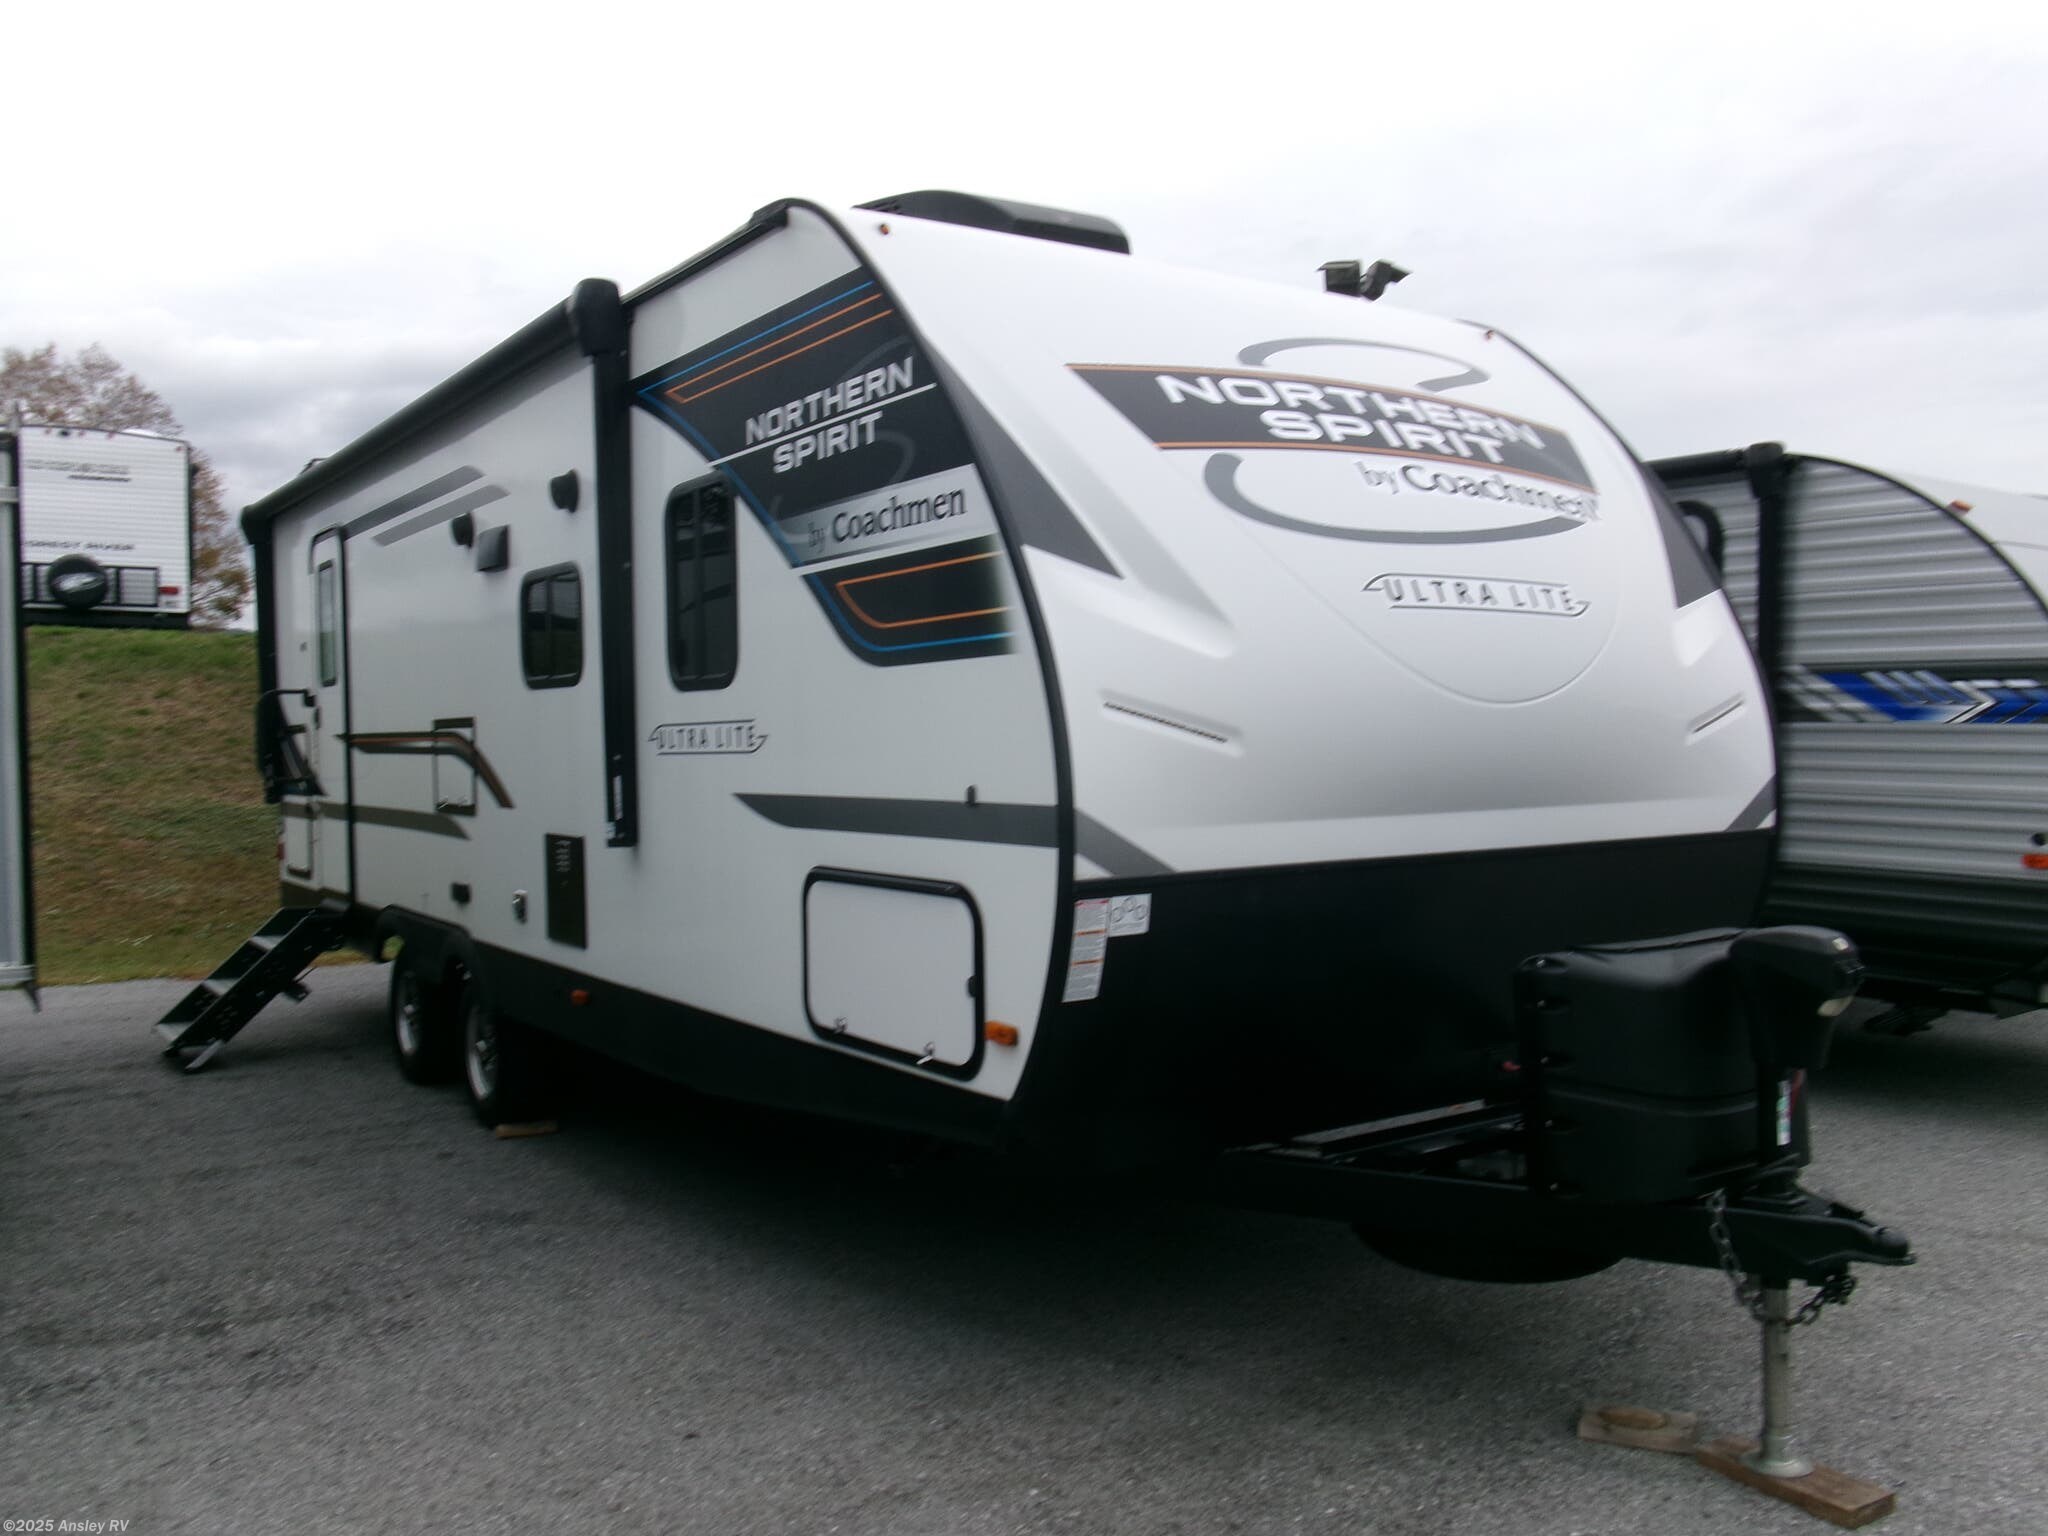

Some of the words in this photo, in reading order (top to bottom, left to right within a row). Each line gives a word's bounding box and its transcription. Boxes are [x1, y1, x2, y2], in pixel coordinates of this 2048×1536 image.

[745, 356, 914, 446] NORTHERN
[1155, 374, 1546, 450] NORTHERN
[773, 410, 883, 474] SPIRIT
[1259, 409, 1505, 464] SPIRIT
[807, 521, 826, 553] by
[832, 488, 968, 543] Coachmen
[1353, 460, 1399, 495] by
[1400, 464, 1600, 521] Coachmen
[1382, 578, 1498, 606] ULTRA
[1507, 585, 1577, 612] LITE
[656, 727, 709, 750] ULTRA
[714, 725, 756, 748] LITE
